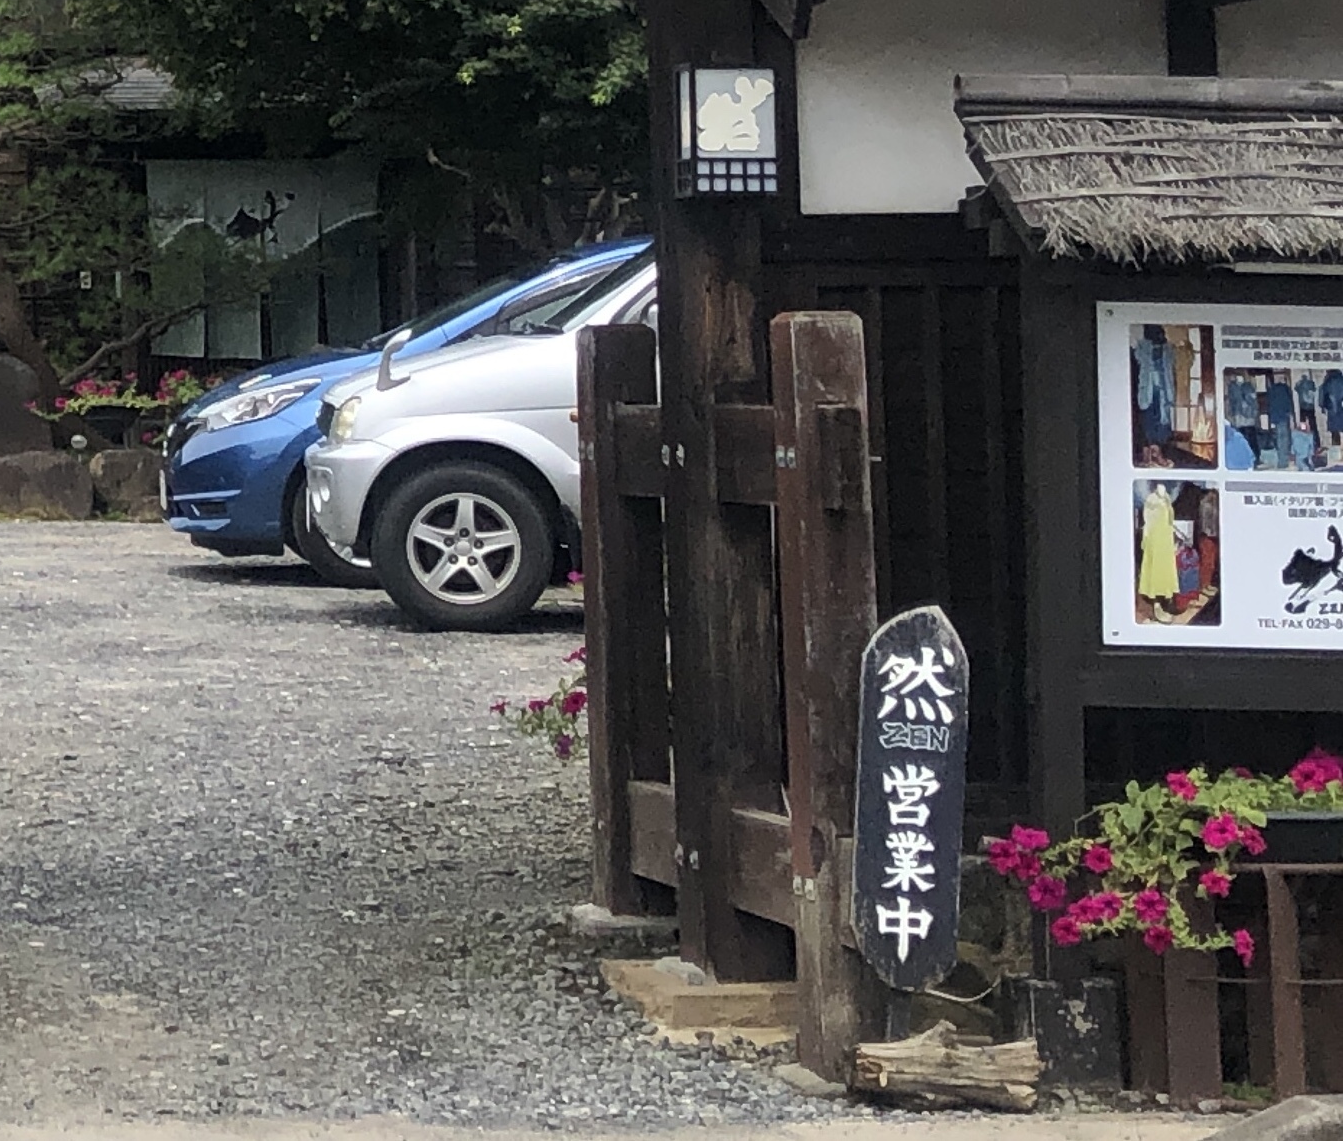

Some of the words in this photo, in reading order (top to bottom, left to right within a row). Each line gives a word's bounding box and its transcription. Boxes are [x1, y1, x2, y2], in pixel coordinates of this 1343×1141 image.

[877, 646, 956, 724] 然
[879, 722, 950, 752] ZEN
[875, 763, 941, 963] 営業中
